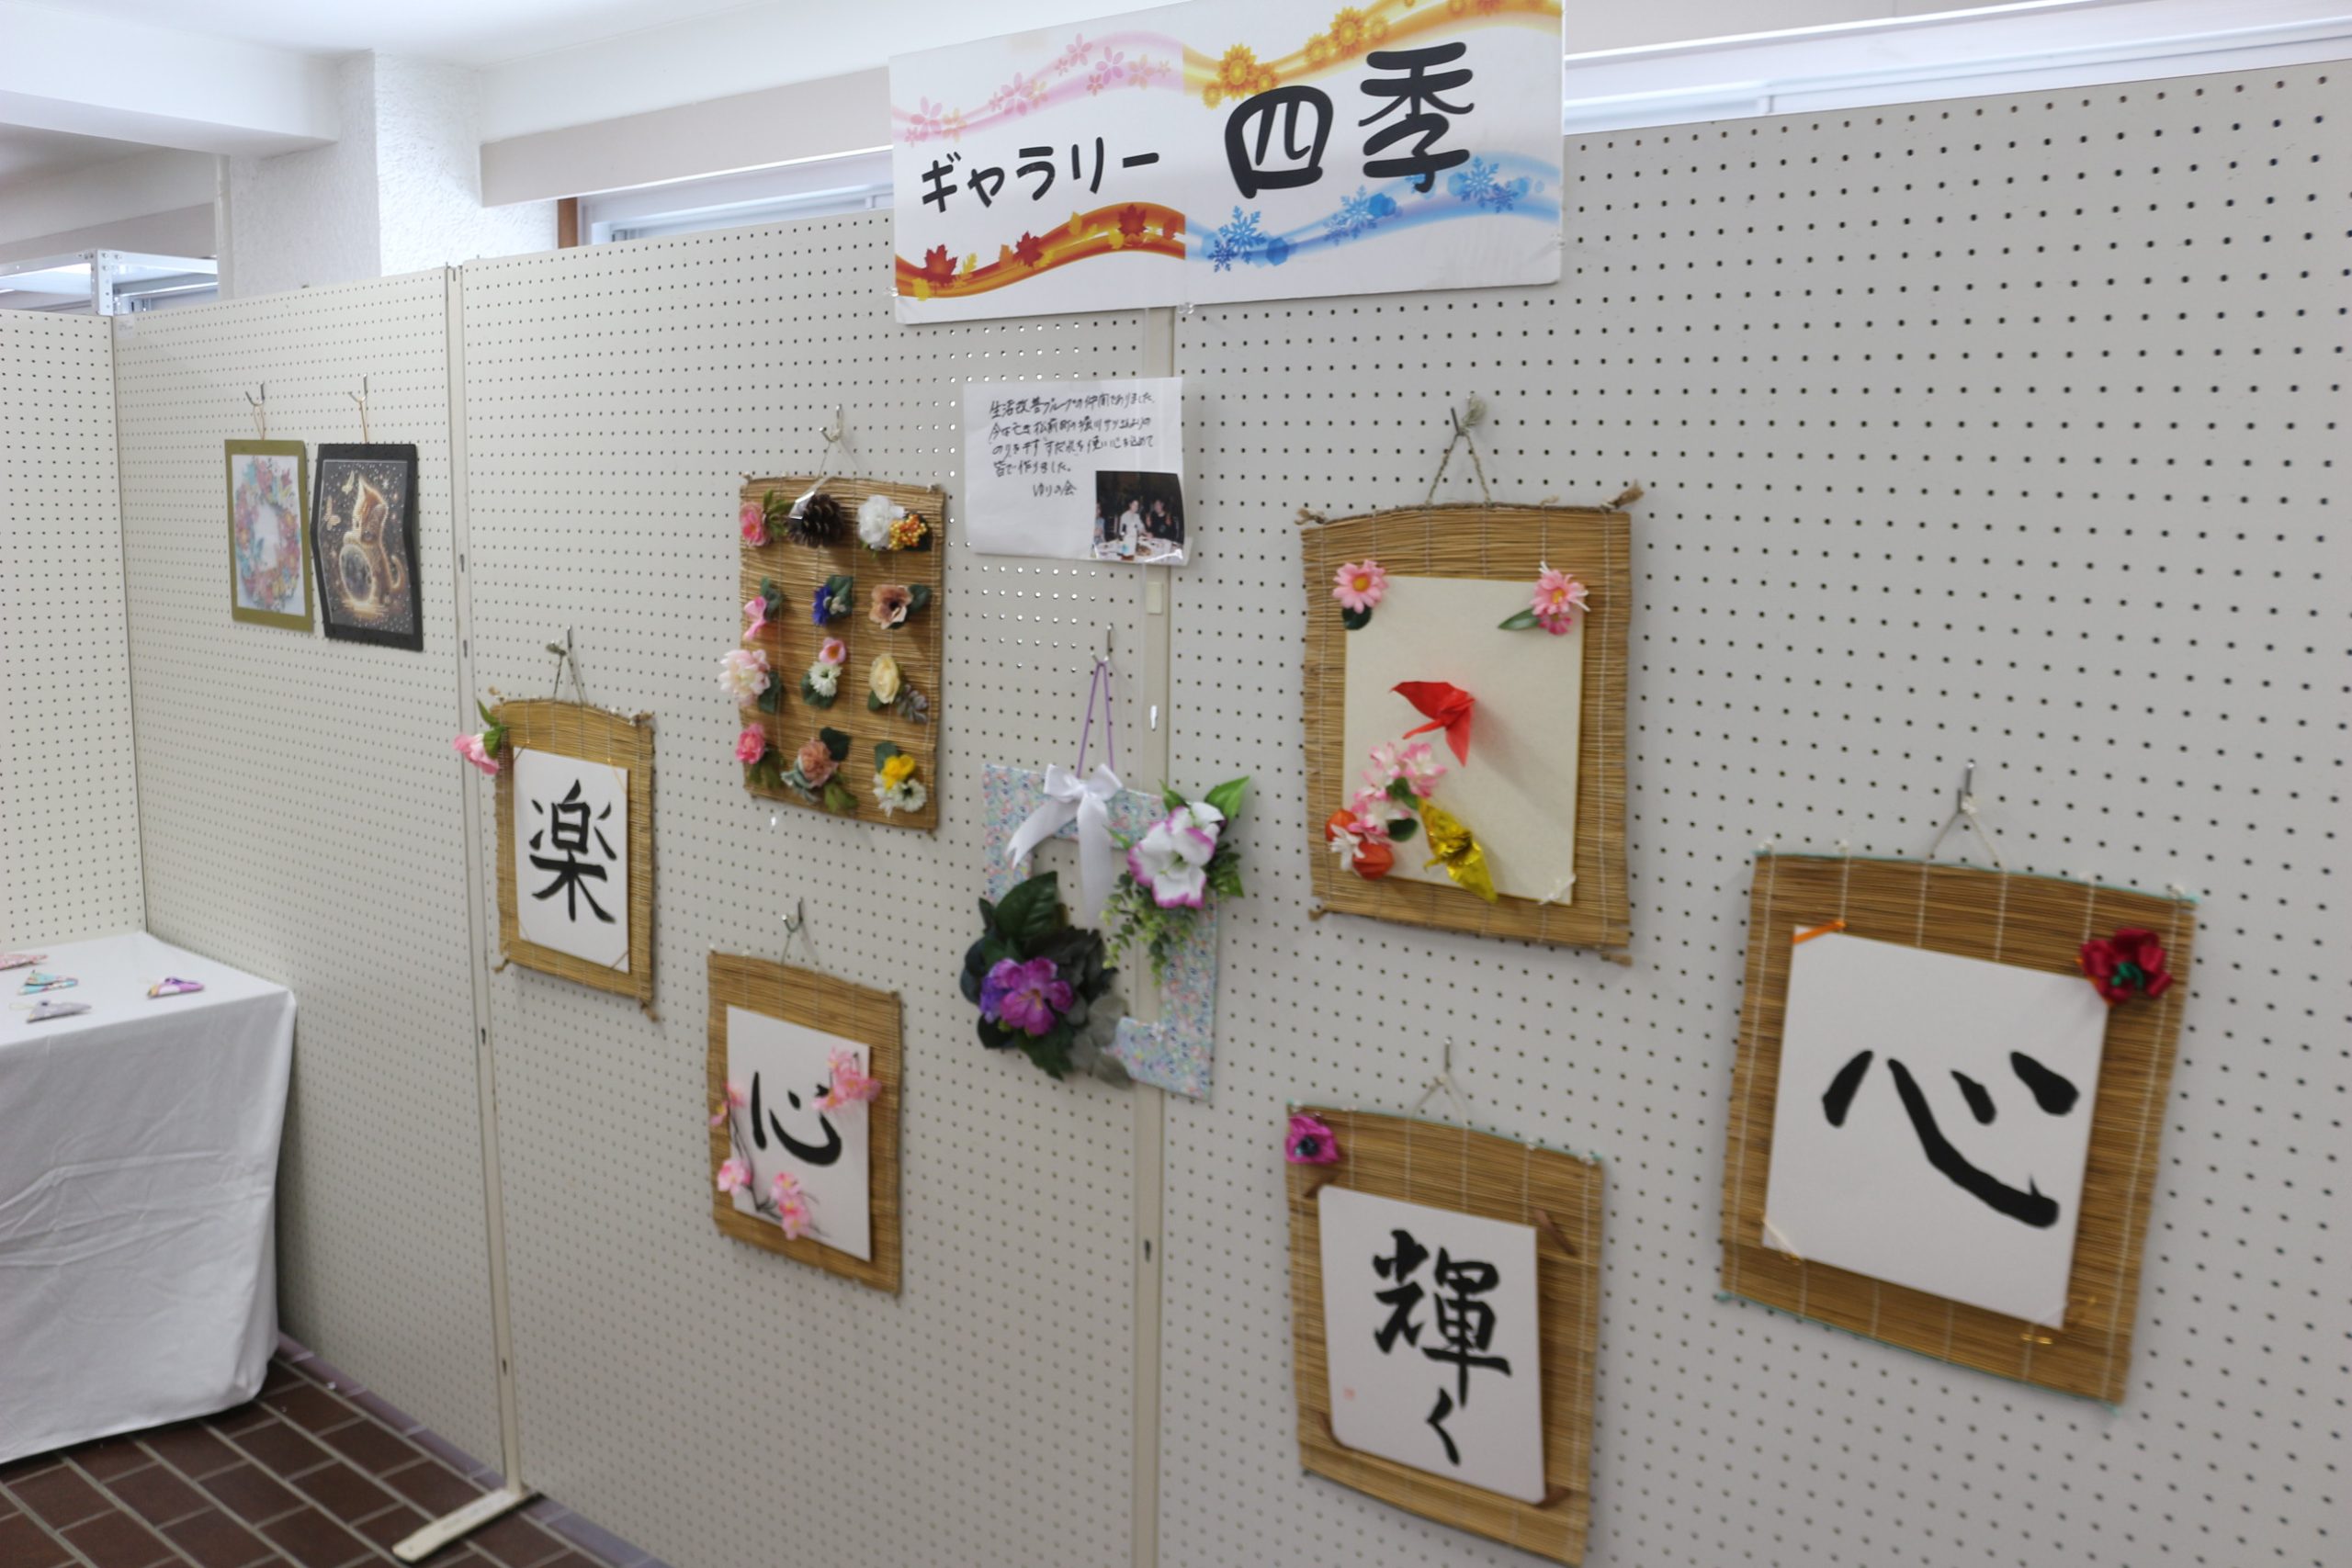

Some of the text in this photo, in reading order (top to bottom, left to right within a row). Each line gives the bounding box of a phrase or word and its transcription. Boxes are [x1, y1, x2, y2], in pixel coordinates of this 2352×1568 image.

[922, 41, 1475, 213] ギャラリー 四季
[528, 778, 617, 924] 楽
[750, 1071, 842, 1168] 心
[1821, 1049, 2079, 1230] 心
[1371, 1229, 1512, 1467] 輝く
